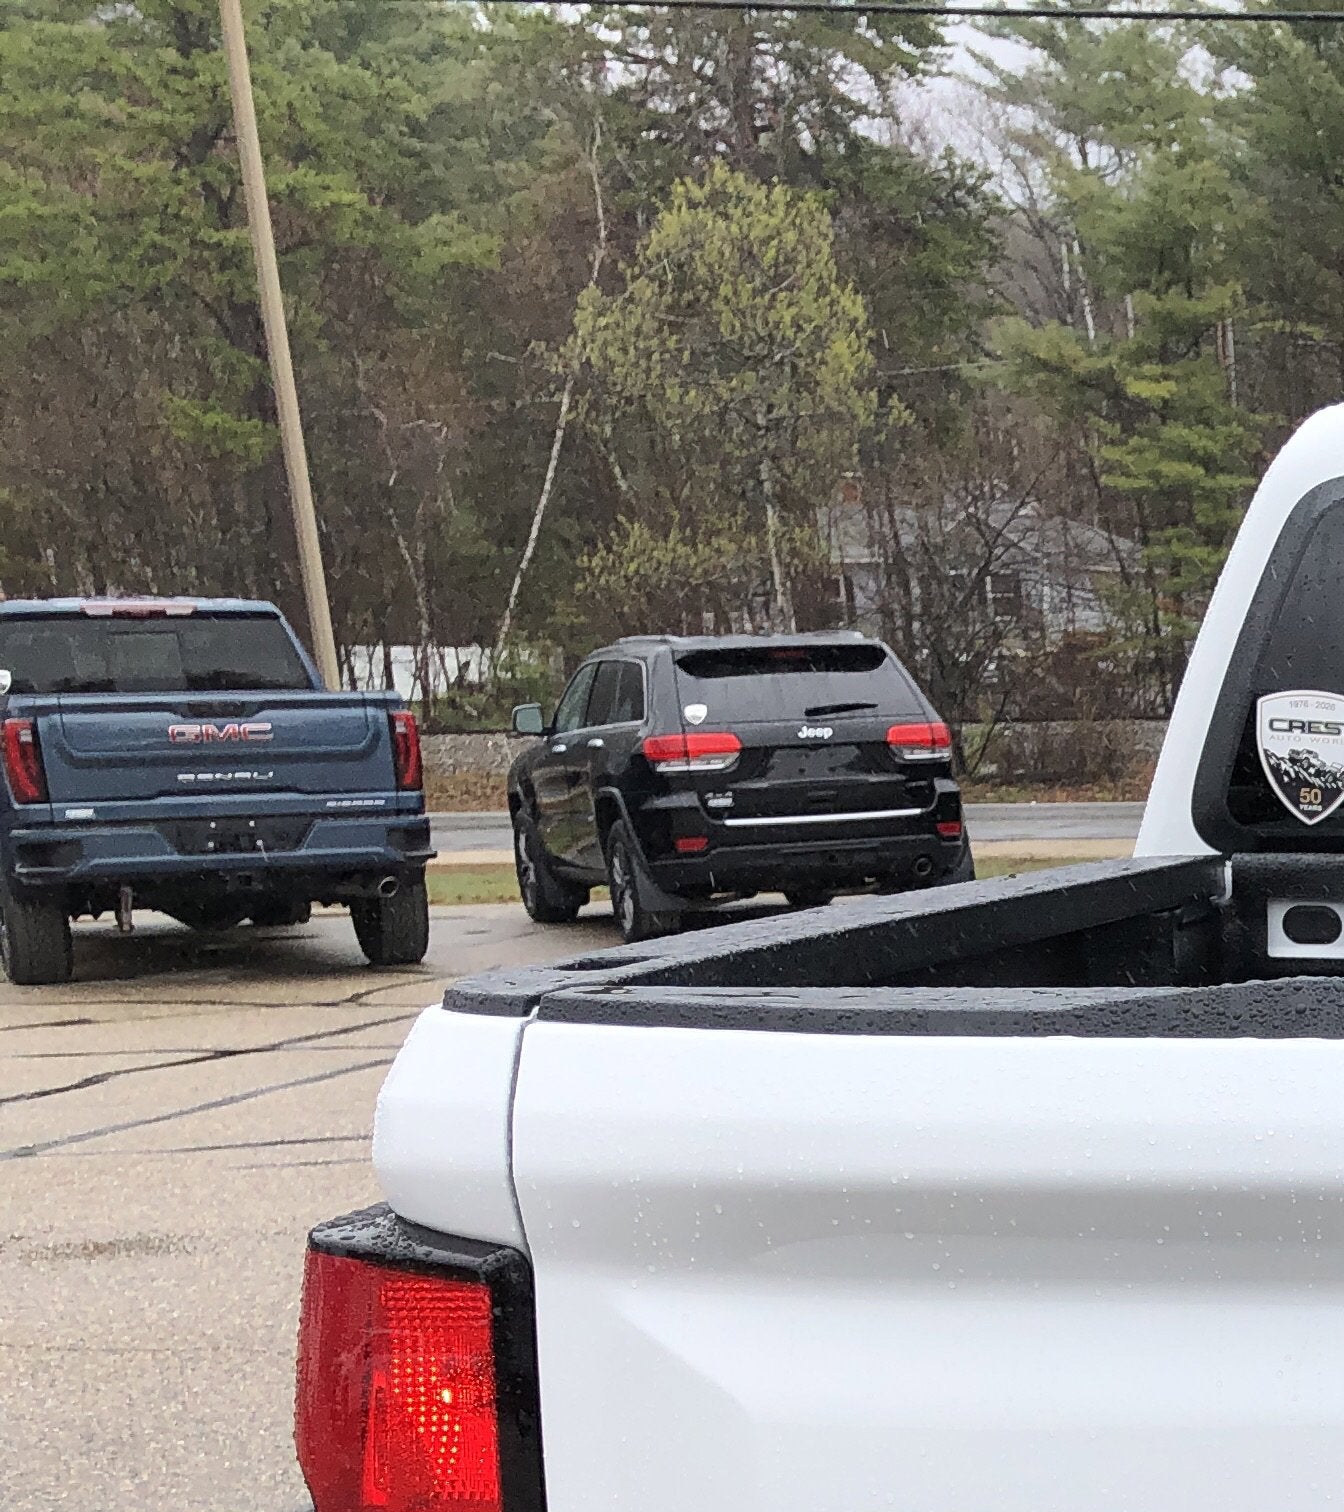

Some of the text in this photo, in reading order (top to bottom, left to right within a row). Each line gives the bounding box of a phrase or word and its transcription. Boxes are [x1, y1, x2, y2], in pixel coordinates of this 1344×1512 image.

[168, 722, 274, 743] GMC
[798, 725, 833, 739] Jeep
[1269, 734, 1302, 743] AUTO
[1300, 787, 1322, 804] 50
